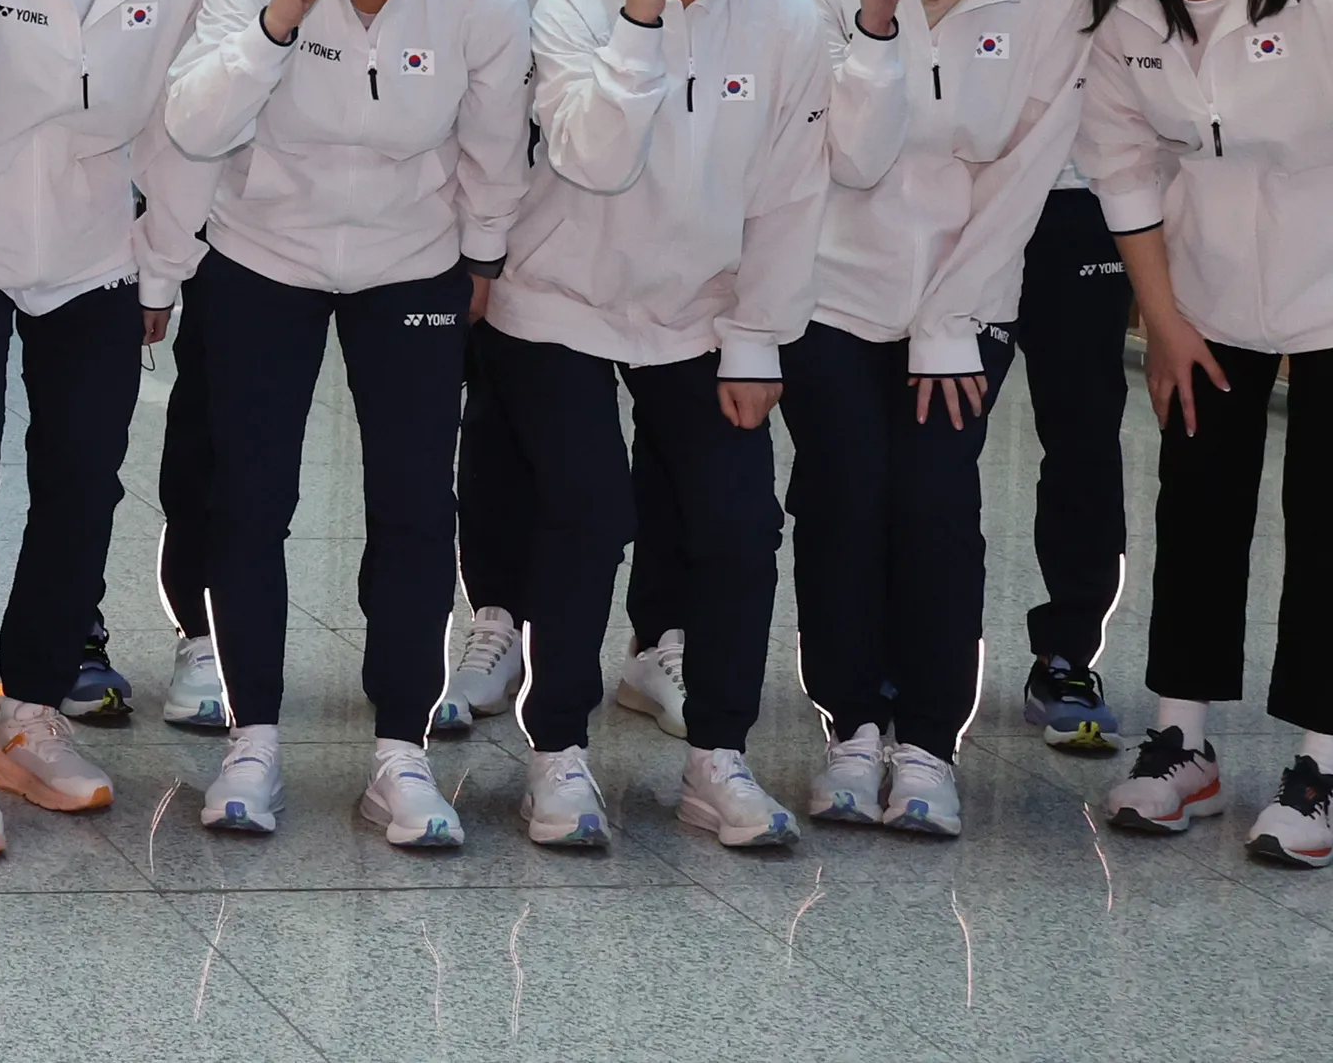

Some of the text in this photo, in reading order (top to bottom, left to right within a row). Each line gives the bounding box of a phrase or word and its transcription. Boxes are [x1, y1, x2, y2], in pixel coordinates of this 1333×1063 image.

[16, 8, 48, 26] YONEX
[307, 42, 342, 62] YONEX
[1137, 57, 1162, 69] YONE
[1099, 262, 1124, 274] YONE
[426, 314, 457, 326] YONEX
